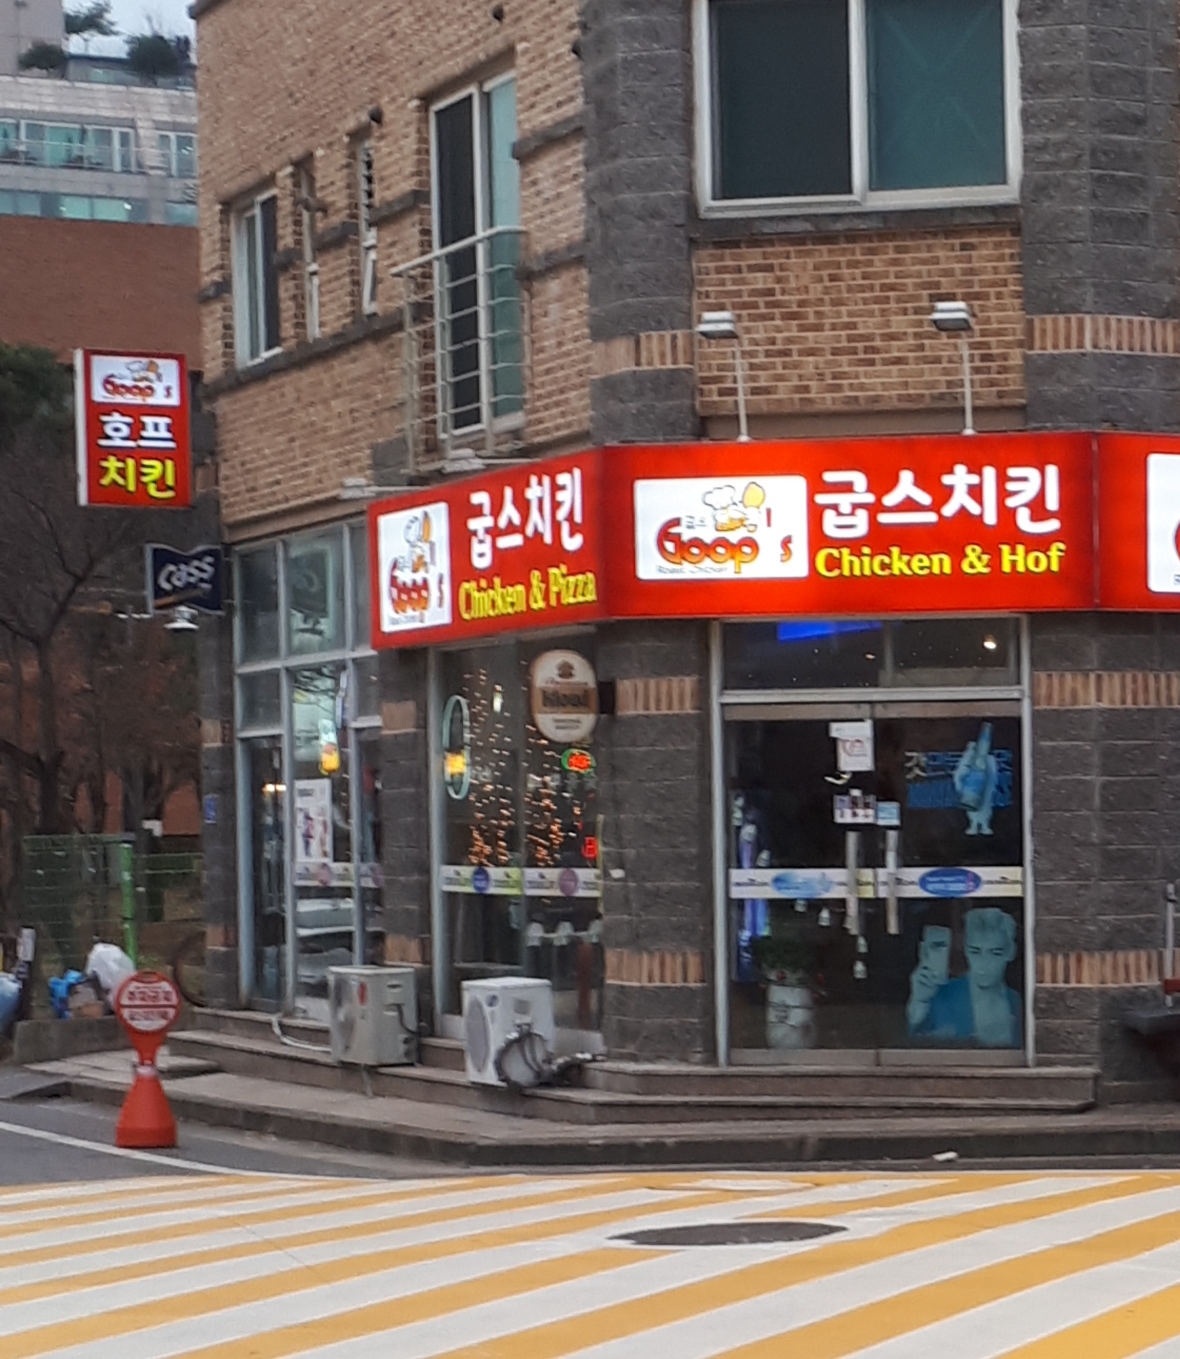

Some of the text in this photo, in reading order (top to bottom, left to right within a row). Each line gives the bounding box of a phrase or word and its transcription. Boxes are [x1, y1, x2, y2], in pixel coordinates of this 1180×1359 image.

[97, 412, 178, 449] 호프
[99, 456, 177, 499] 치킨
[813, 464, 1062, 540] 굽스치킨
[466, 467, 584, 570] 굽스치킨
[815, 542, 1067, 578] Chicken & Hof
[459, 563, 597, 620] Chicken & Pizza
